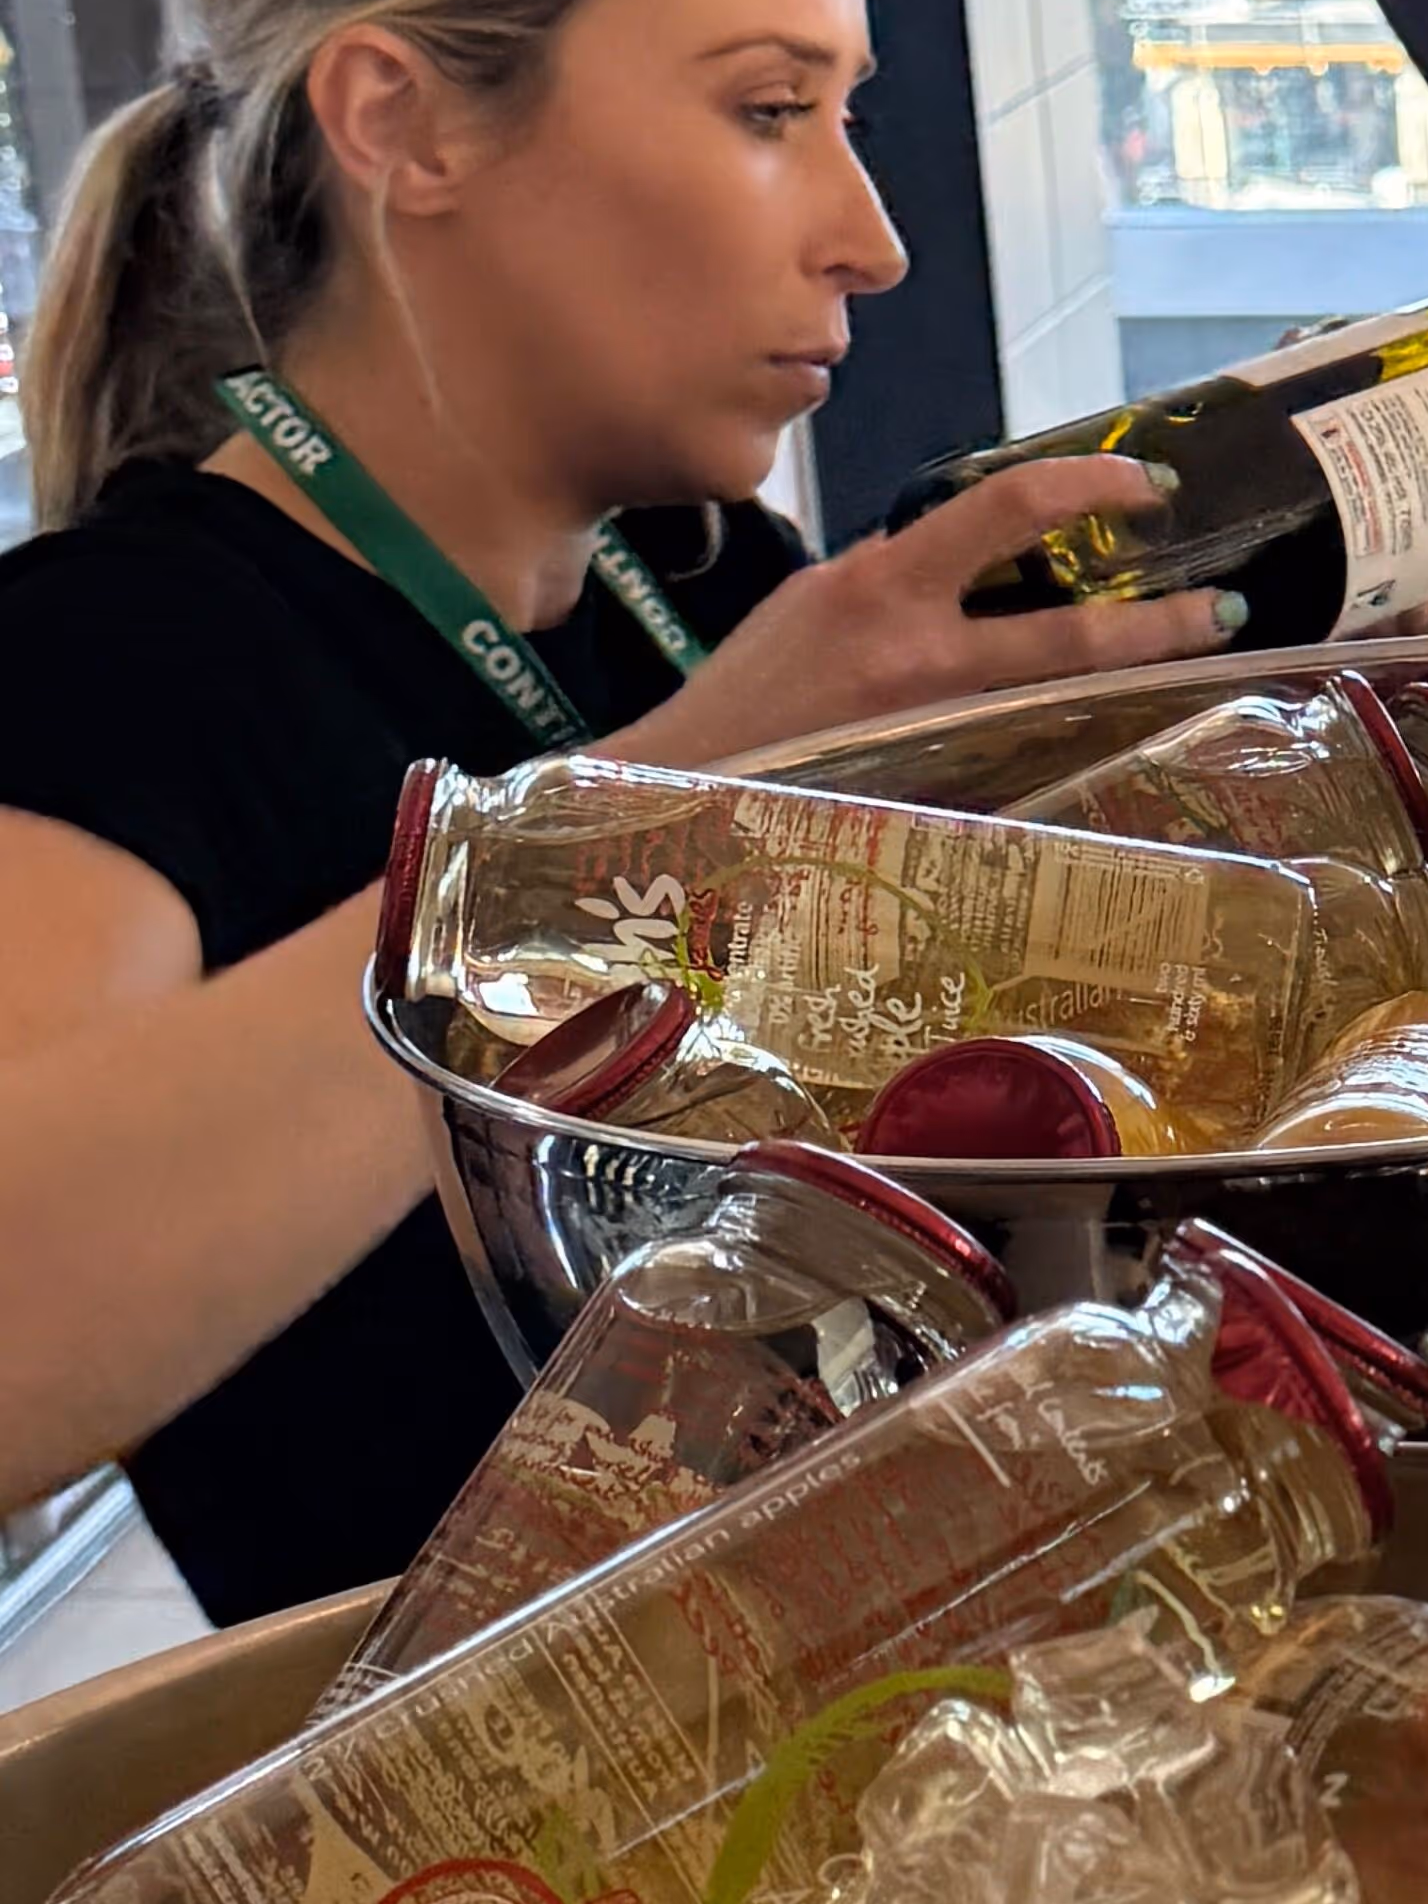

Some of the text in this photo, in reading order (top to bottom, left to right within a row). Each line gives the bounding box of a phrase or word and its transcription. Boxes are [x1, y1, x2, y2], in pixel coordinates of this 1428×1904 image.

[225, 370, 333, 475] ACTOR
[462, 618, 576, 738] CONT
[742, 1449, 862, 1531] apples
